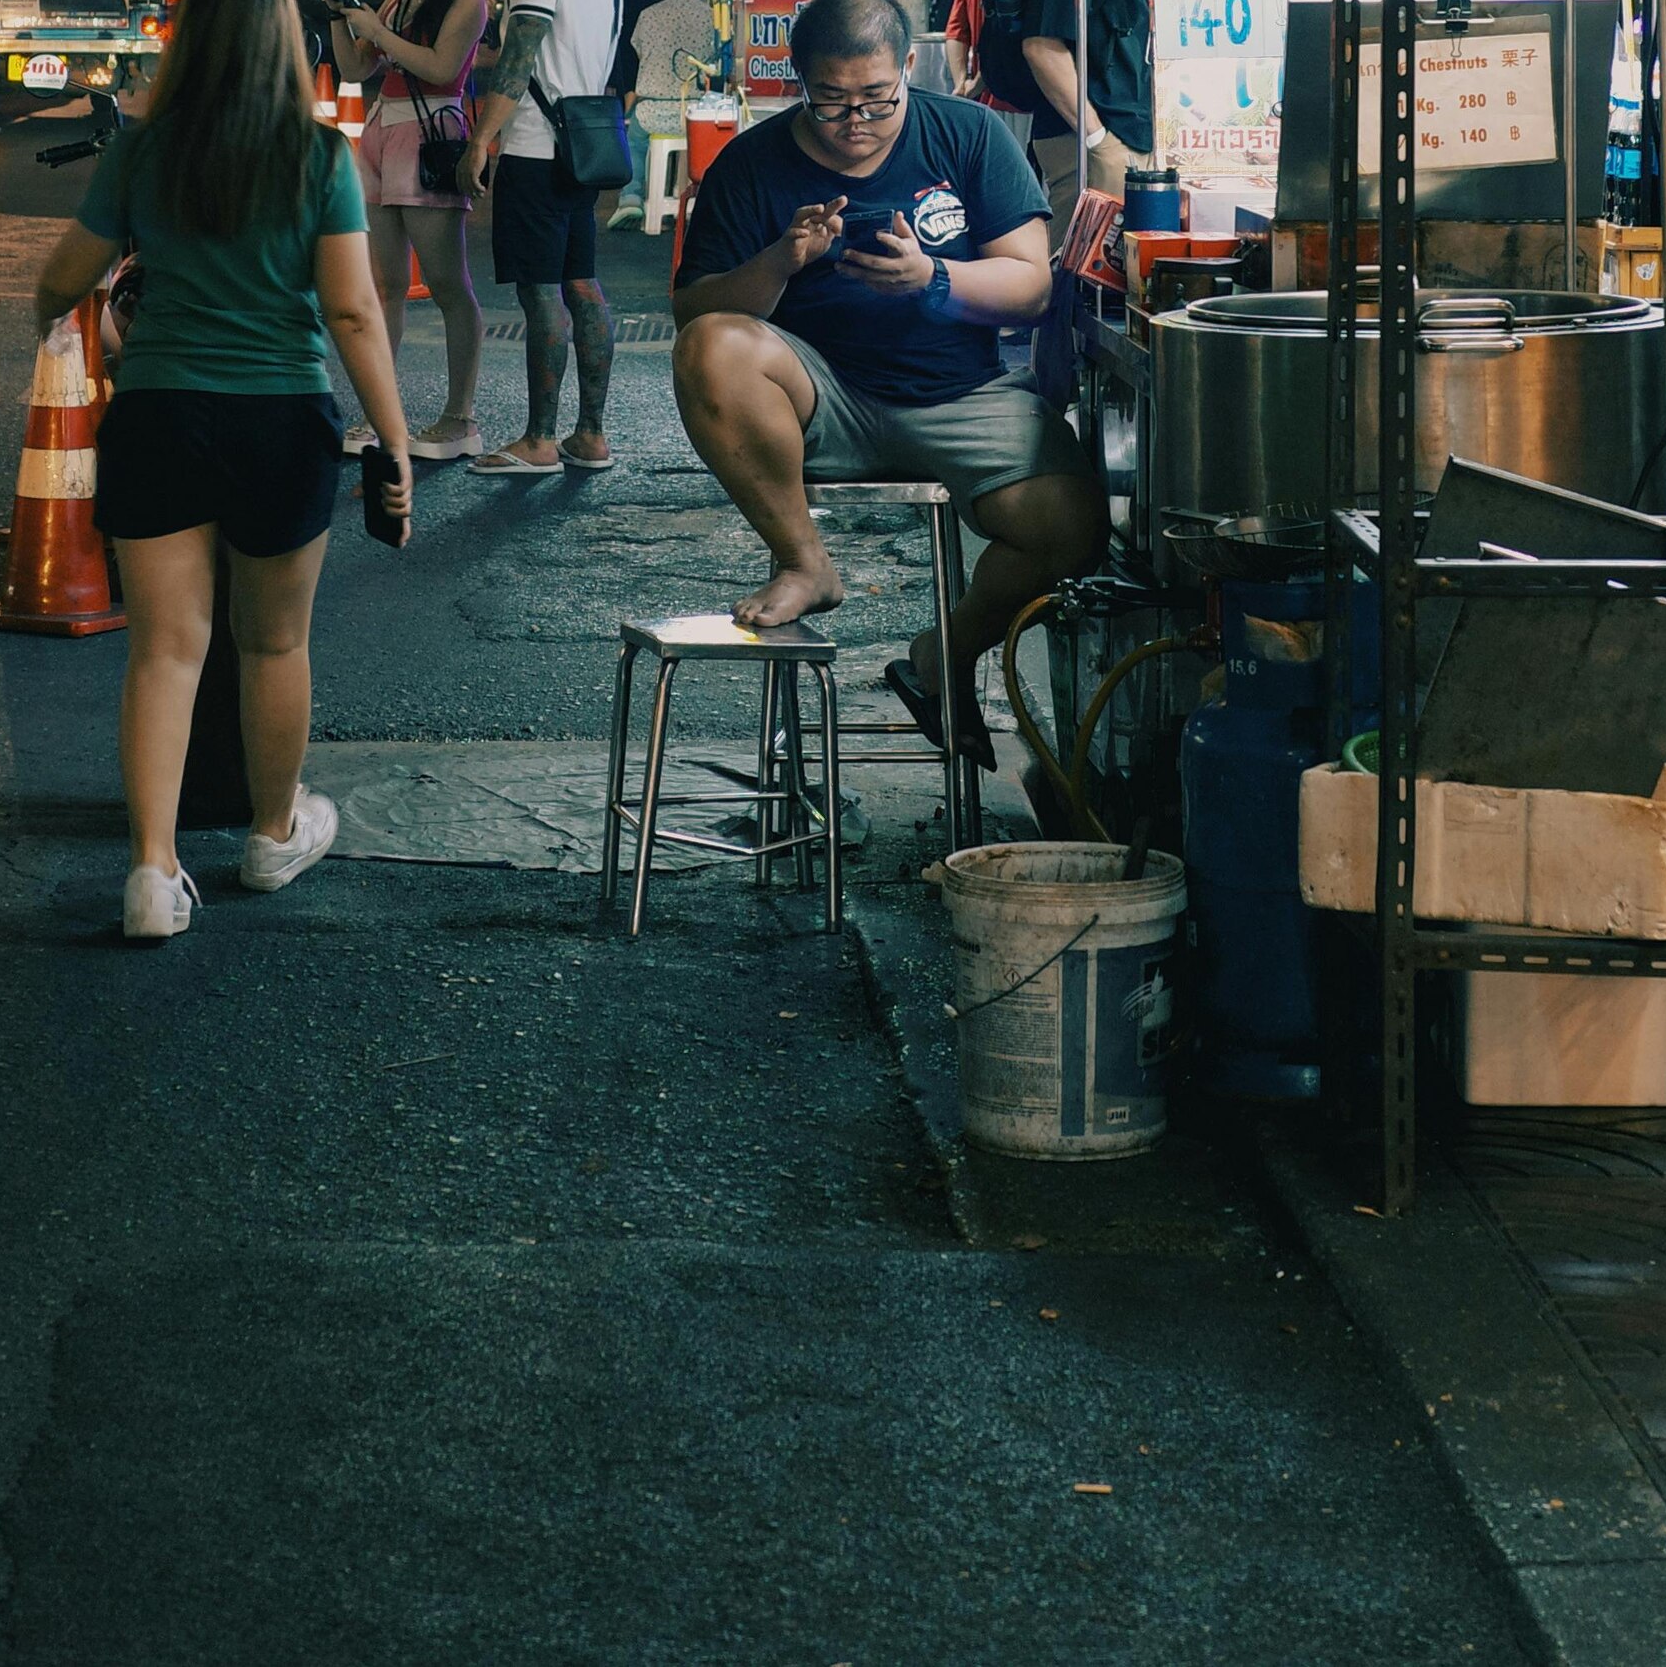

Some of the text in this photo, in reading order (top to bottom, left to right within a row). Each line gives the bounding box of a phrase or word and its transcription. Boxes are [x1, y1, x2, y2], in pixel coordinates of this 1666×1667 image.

[1419, 56, 1488, 73] Chestnuts
[1501, 48, 1539, 67] 栗子
[1416, 97, 1440, 114] Kg.
[1459, 93, 1487, 109] 280
[1421, 132, 1445, 149] Kg.
[1461, 129, 1488, 143] 140
[920, 211, 966, 238] VANS
